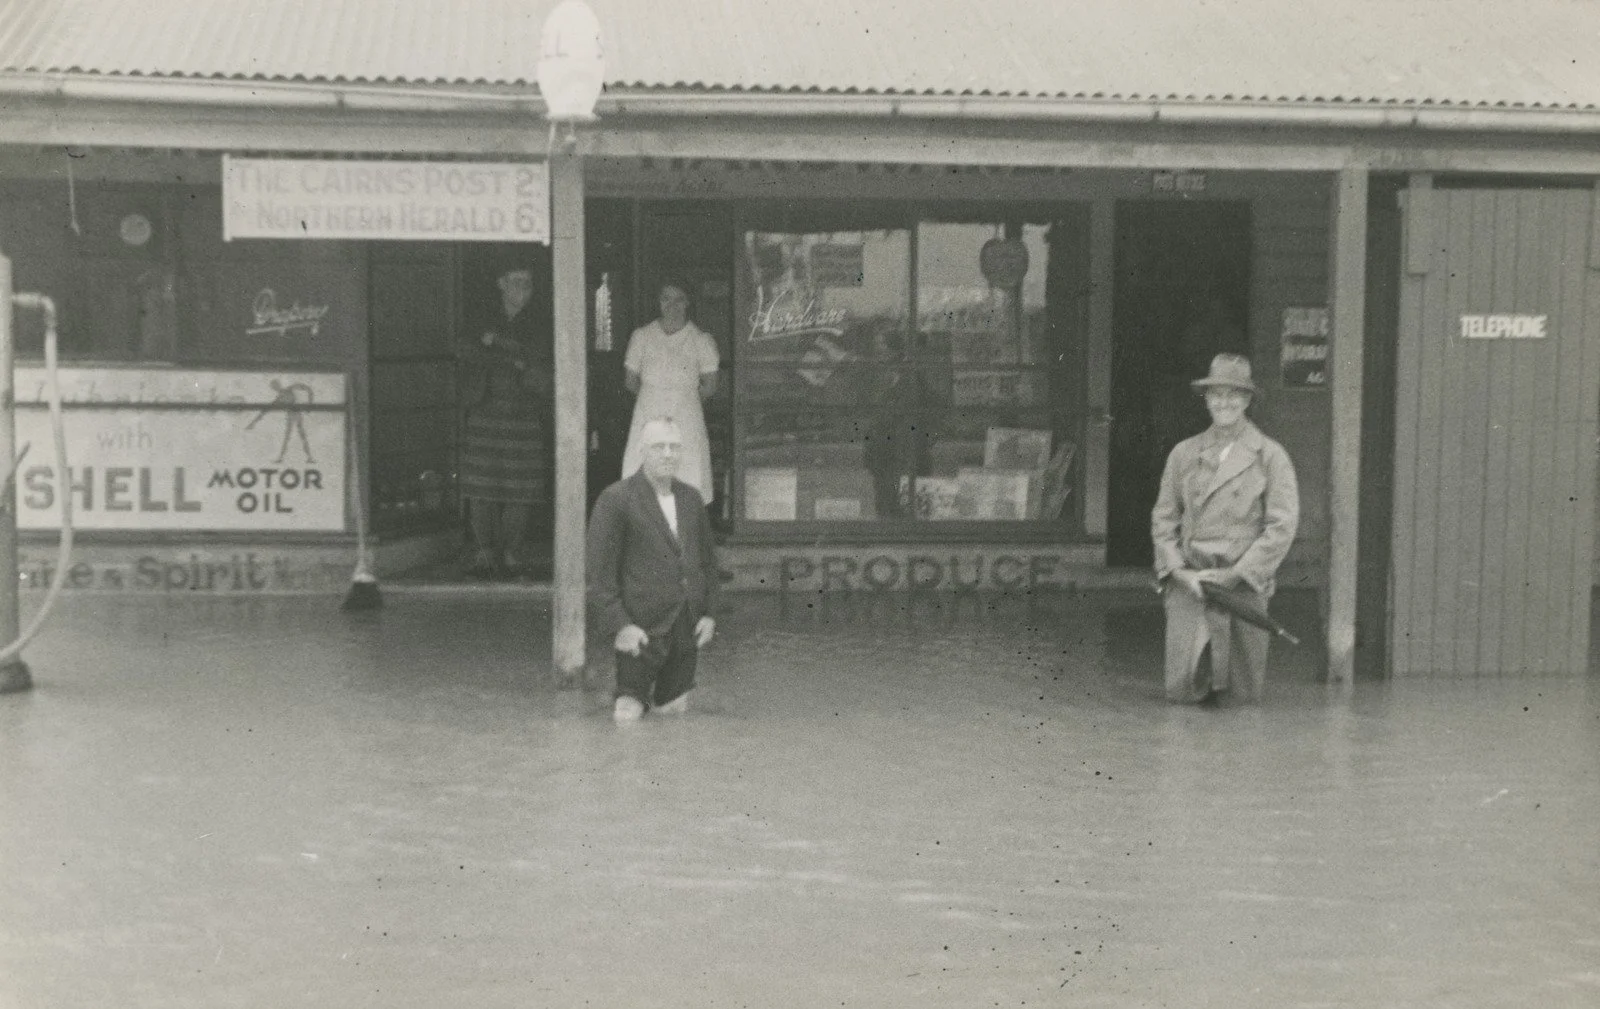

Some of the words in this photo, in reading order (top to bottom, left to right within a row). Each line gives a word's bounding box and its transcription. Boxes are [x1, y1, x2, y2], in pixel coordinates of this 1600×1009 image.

[299, 164, 415, 195] CAIRNS
[424, 166, 511, 197] POST
[256, 201, 394, 231] NORTHERN
[400, 204, 507, 233] HERALD
[1460, 314, 1547, 339] TELEPHONE
[96, 420, 152, 450] with
[23, 465, 202, 512] SHELL
[206, 467, 323, 490] MOTOR
[235, 492, 294, 513] OIL
[134, 553, 268, 591] Spirit
